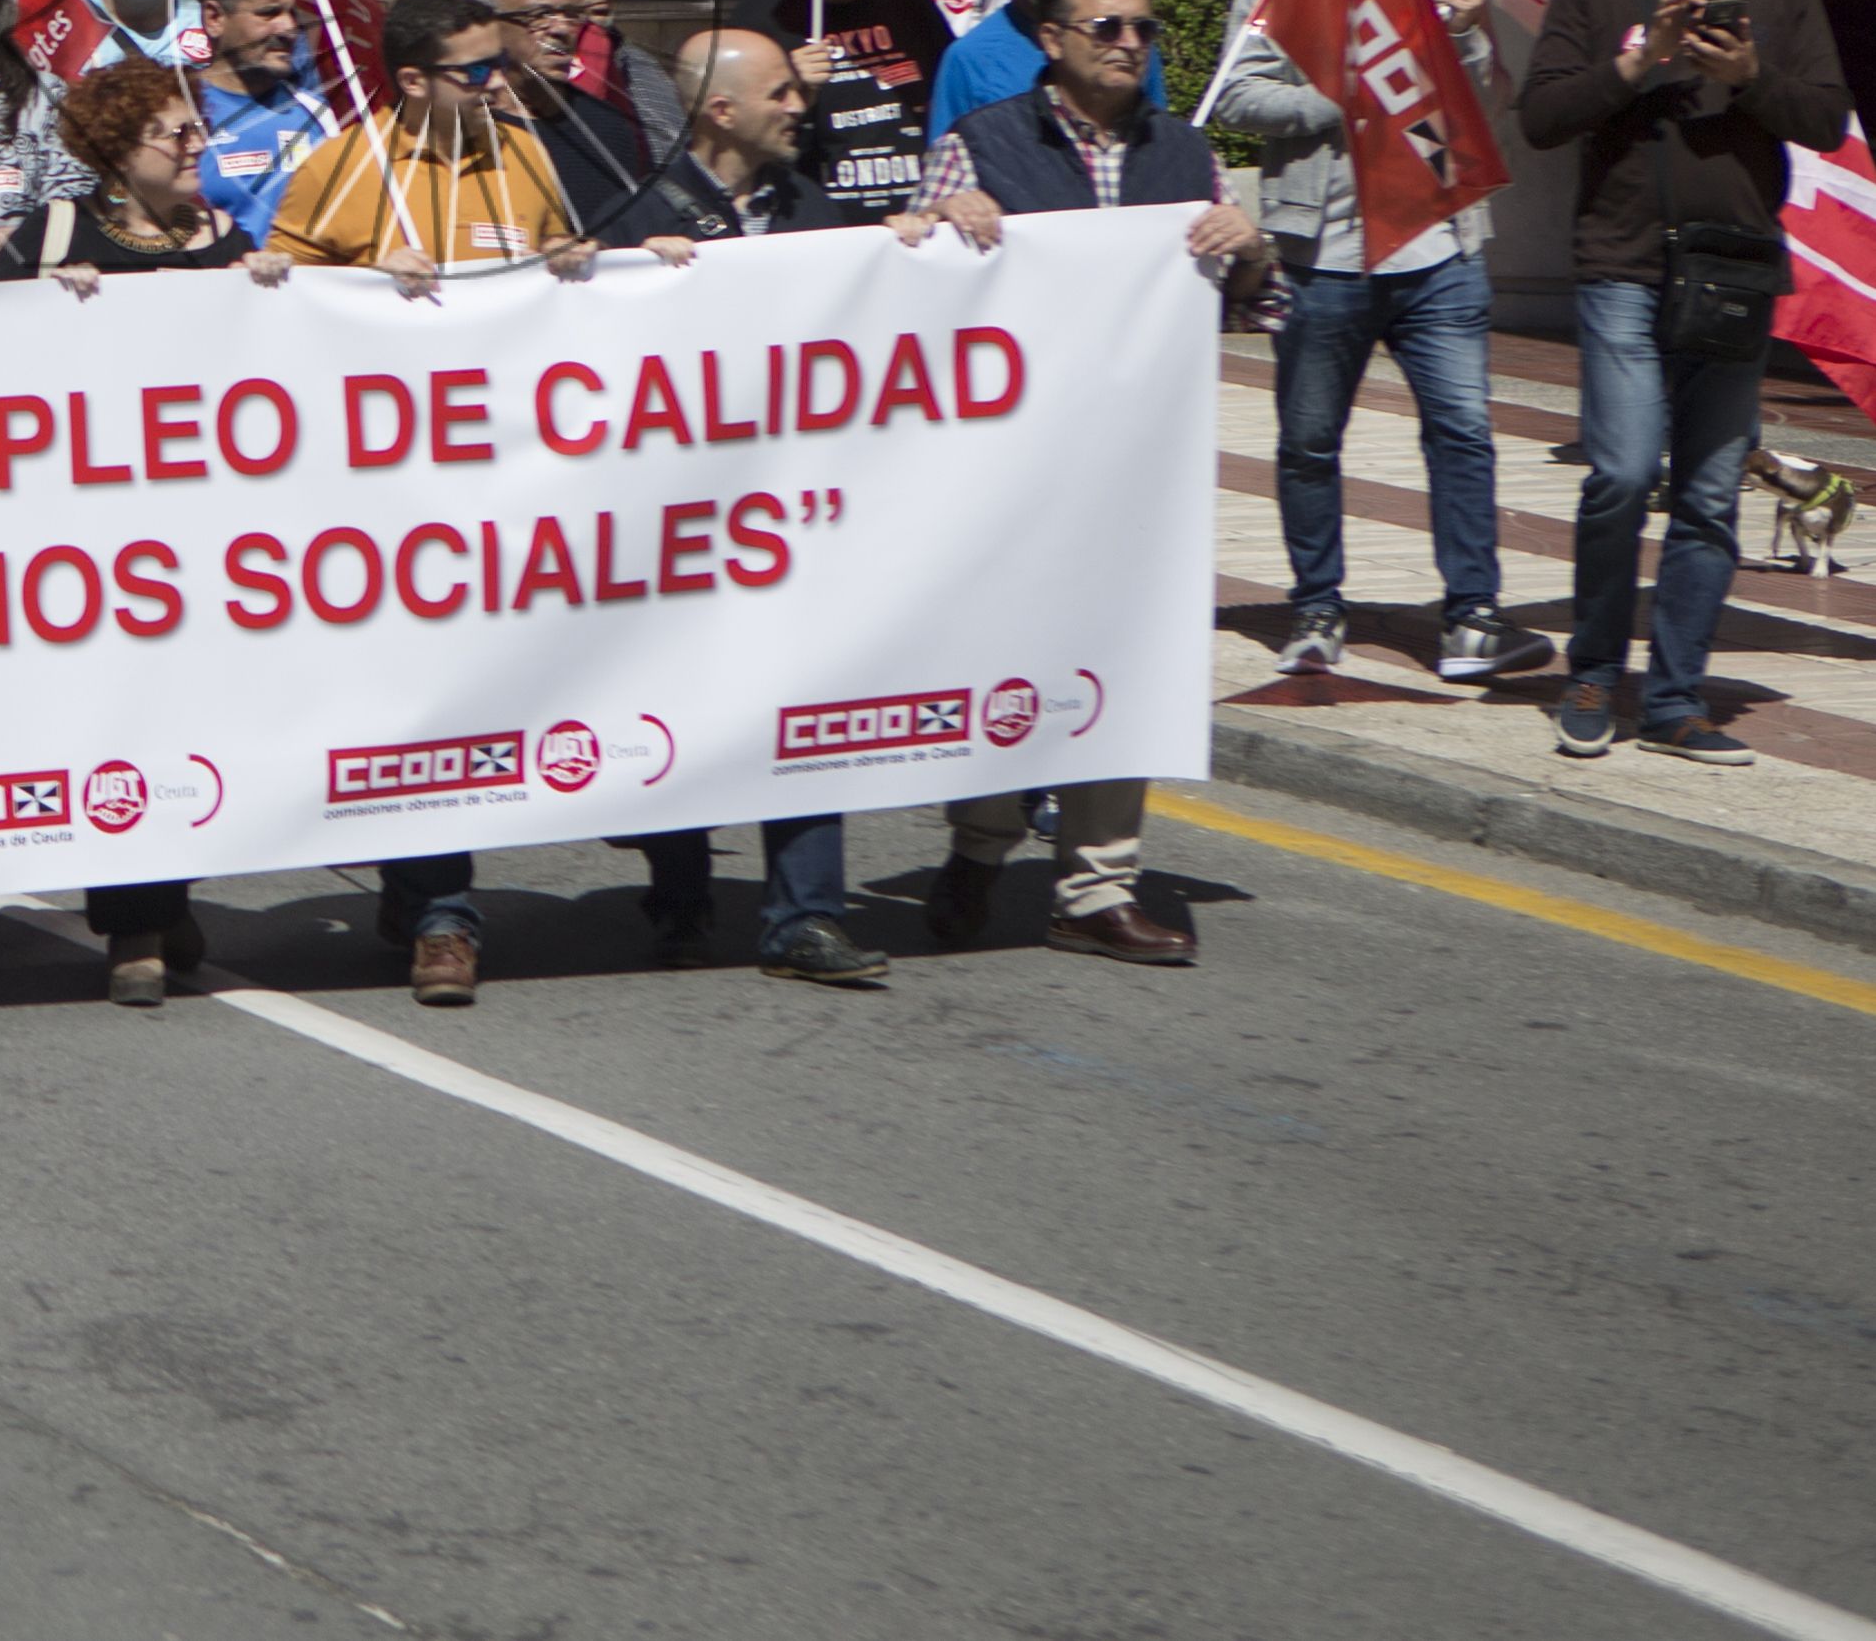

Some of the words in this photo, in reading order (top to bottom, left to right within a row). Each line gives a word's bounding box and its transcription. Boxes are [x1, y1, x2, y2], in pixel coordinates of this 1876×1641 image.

[343, 367, 496, 470] DE
[534, 325, 1028, 456] CALIDAD
[224, 487, 846, 631] SOCIALES”
[334, 747, 466, 793] CCOO
[784, 704, 912, 749] CCOO
